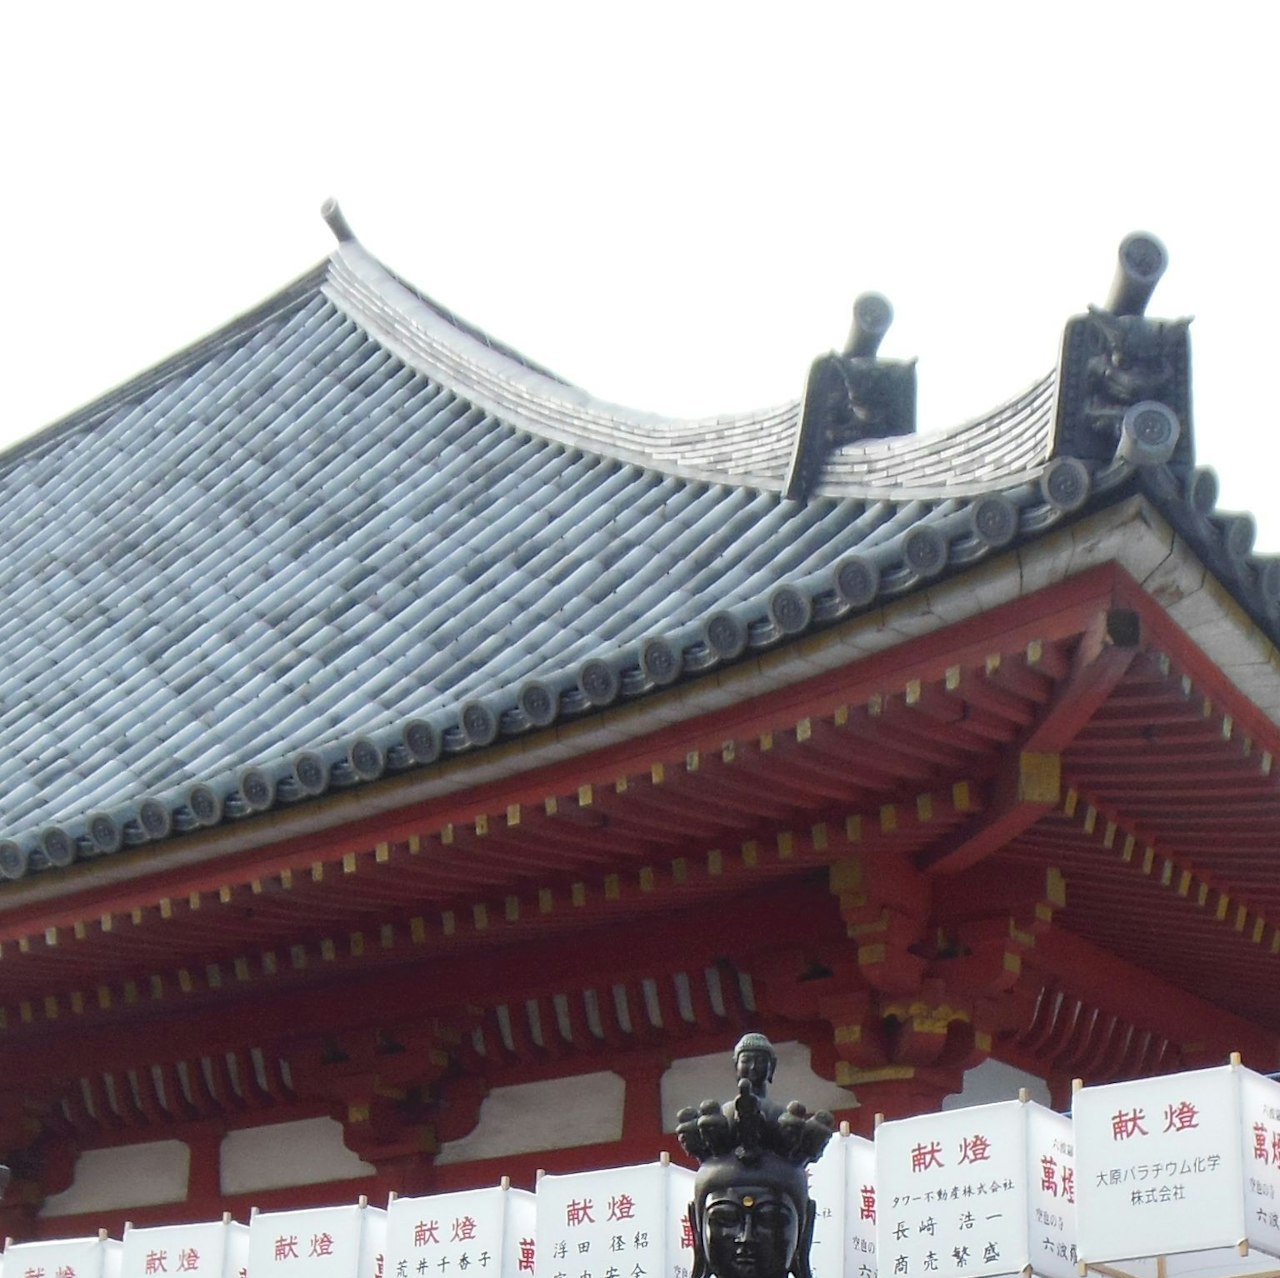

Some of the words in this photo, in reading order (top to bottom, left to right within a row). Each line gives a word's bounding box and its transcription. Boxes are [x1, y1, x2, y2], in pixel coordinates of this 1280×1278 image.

[1111, 1101, 1200, 1141] 献燈
[911, 1134, 992, 1173] 献燈
[567, 1193, 636, 1227] 献燈
[1131, 1185, 1186, 1206] 株式会社
[274, 1232, 334, 1261] 献燈
[414, 1216, 477, 1247] 献燈
[145, 1248, 200, 1275] 献燈
[893, 1241, 1001, 1275] 商売繁盛
